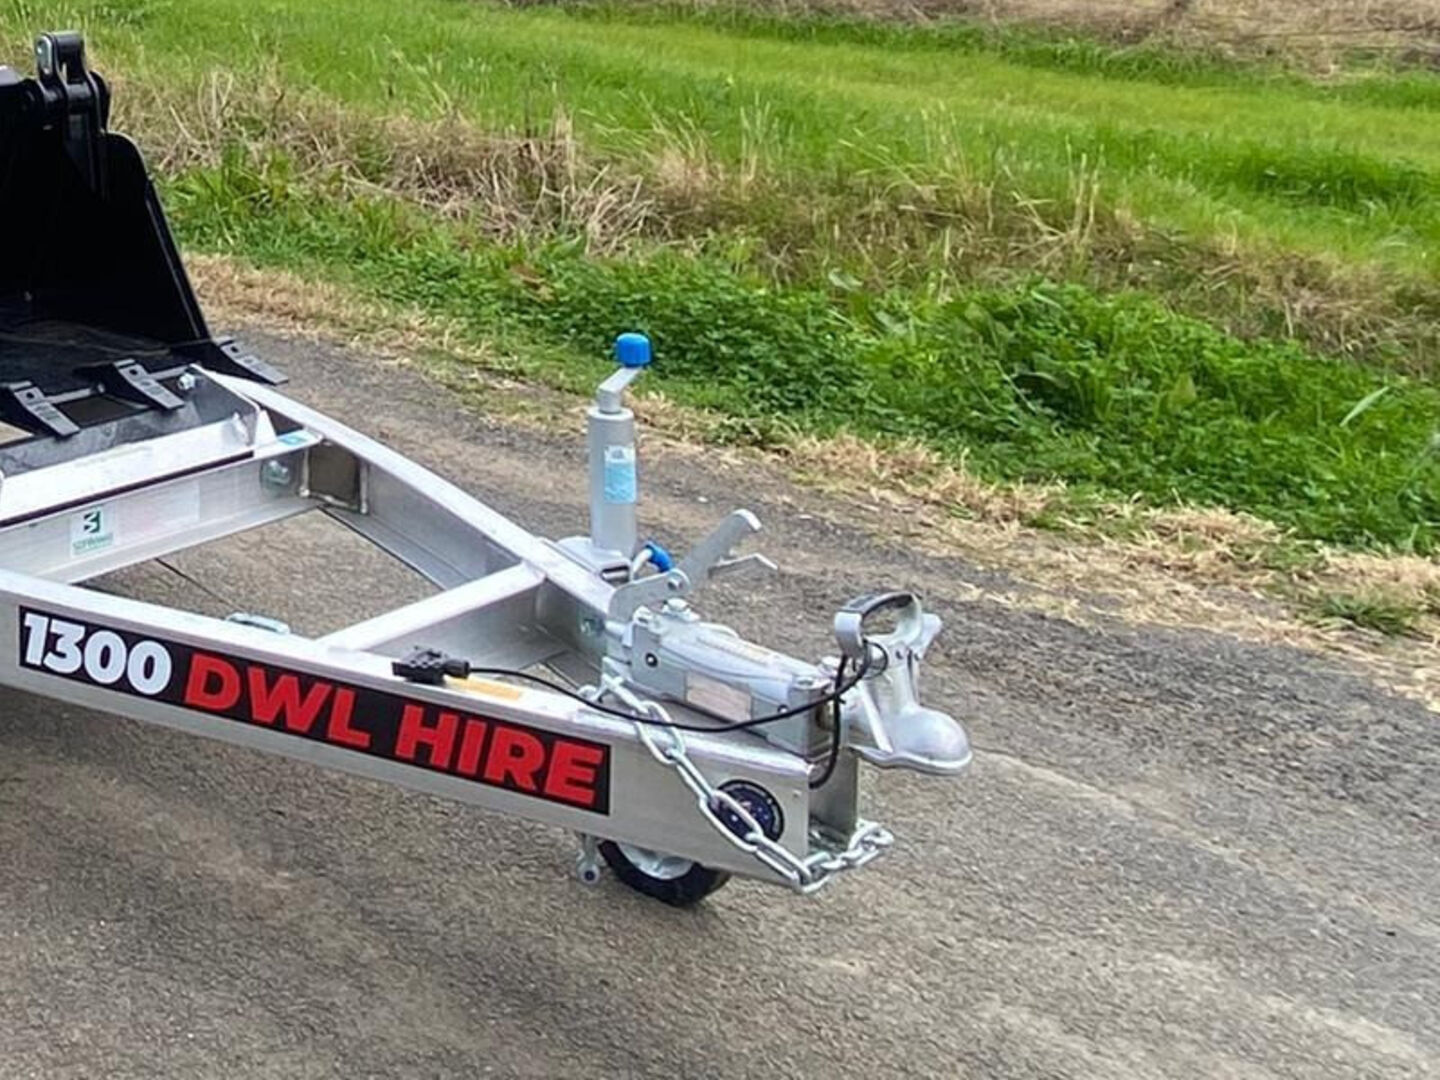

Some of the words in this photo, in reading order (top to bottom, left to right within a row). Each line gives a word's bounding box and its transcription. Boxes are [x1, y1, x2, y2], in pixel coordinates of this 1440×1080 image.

[23, 613, 172, 696] 1300
[184, 652, 371, 748] DWL
[394, 703, 604, 805] HIRE
